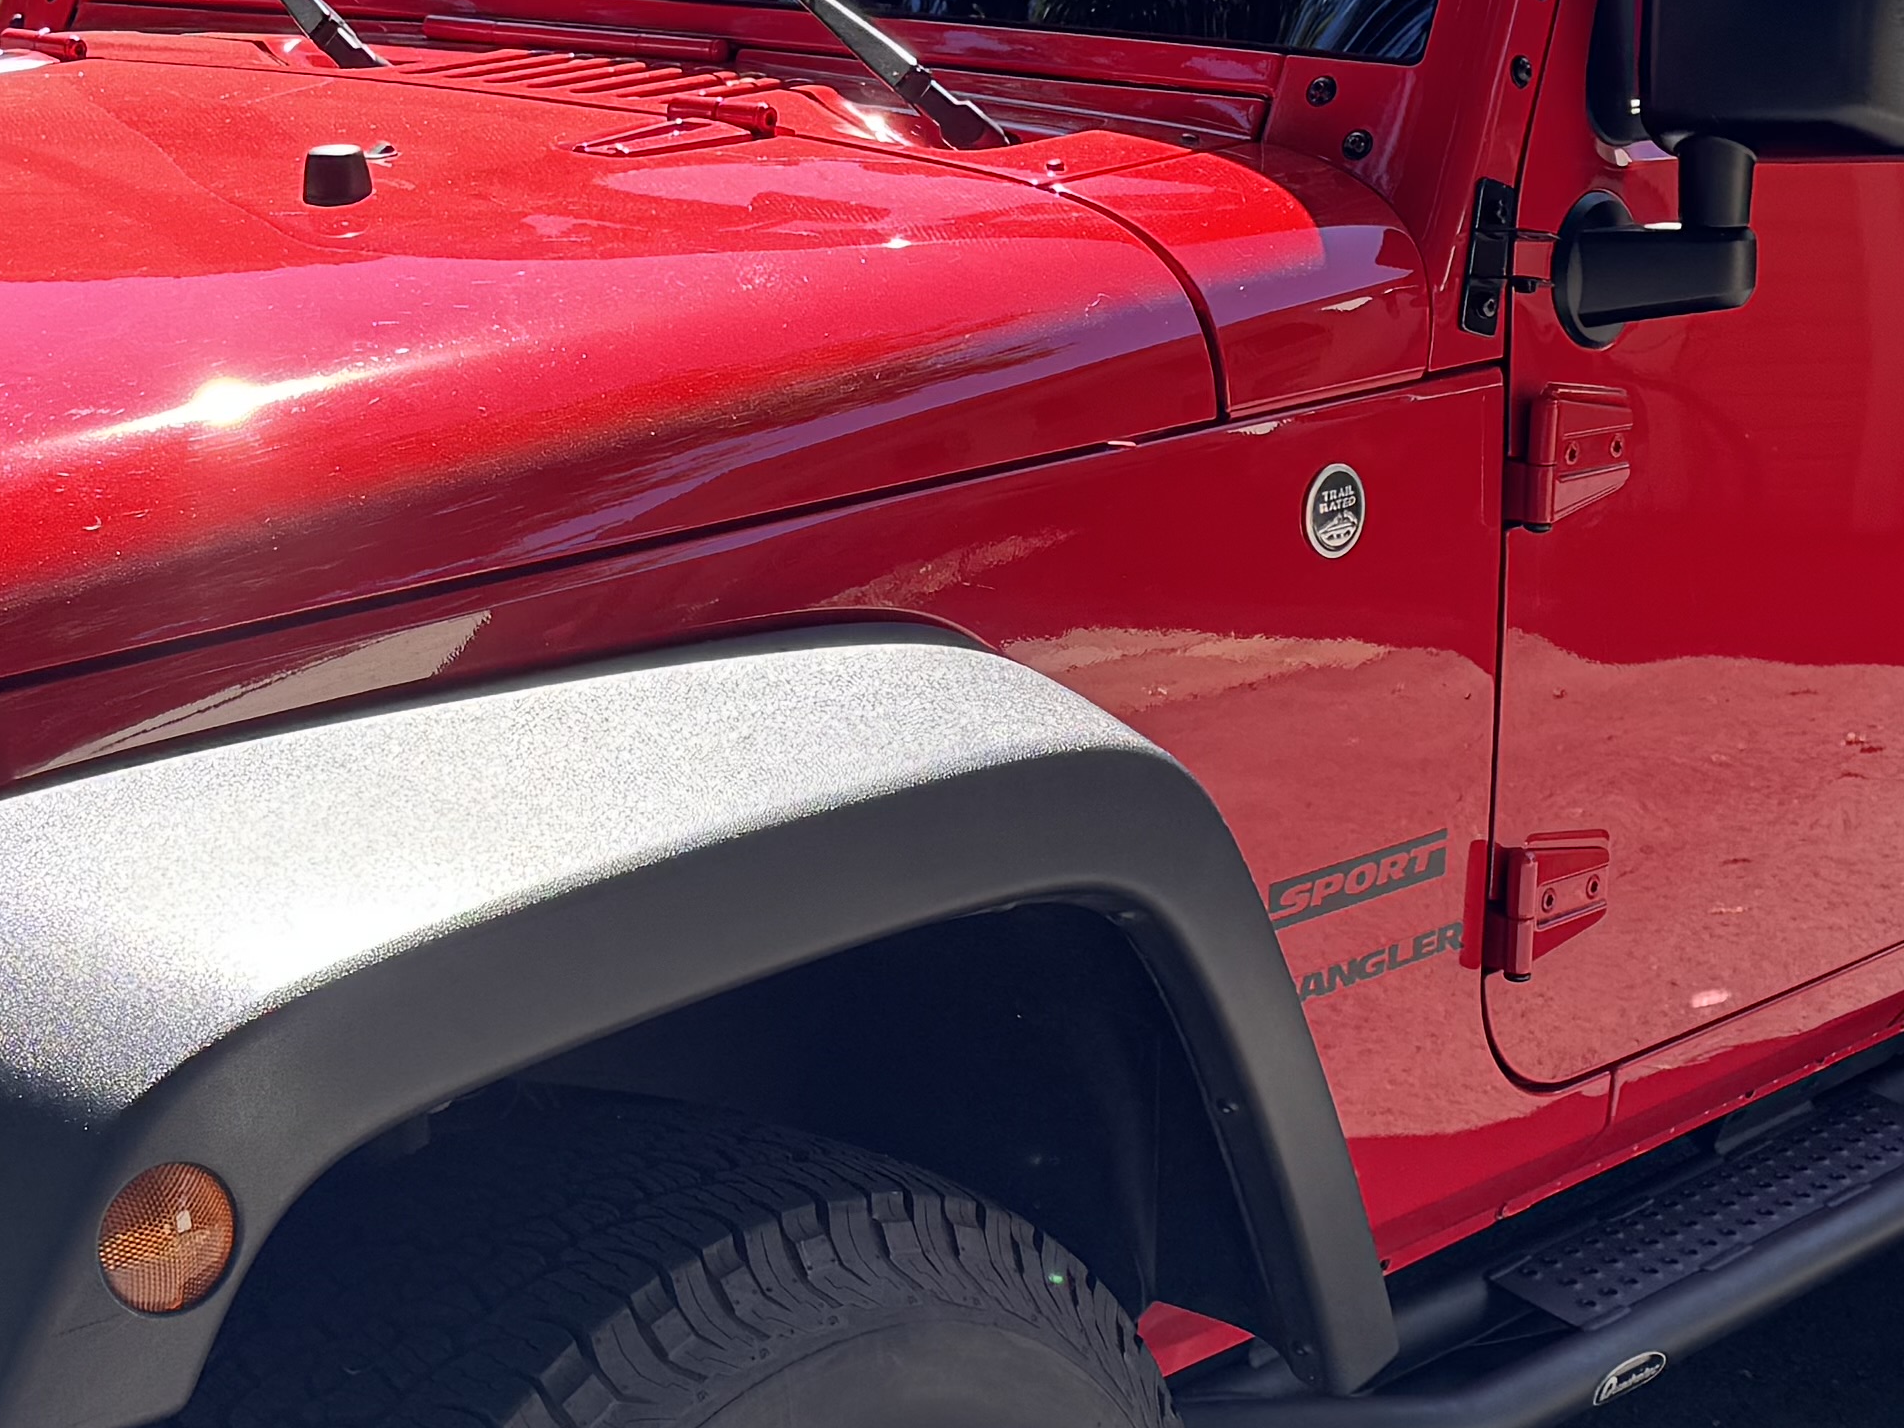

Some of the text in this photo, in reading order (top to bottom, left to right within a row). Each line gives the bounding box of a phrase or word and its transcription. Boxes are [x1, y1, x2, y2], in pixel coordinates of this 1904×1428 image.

[1319, 495, 1356, 514] RATED
[1322, 484, 1355, 503] TRAIL
[1268, 838, 1446, 922] SPORT
[1299, 922, 1464, 1001] ANGLER
